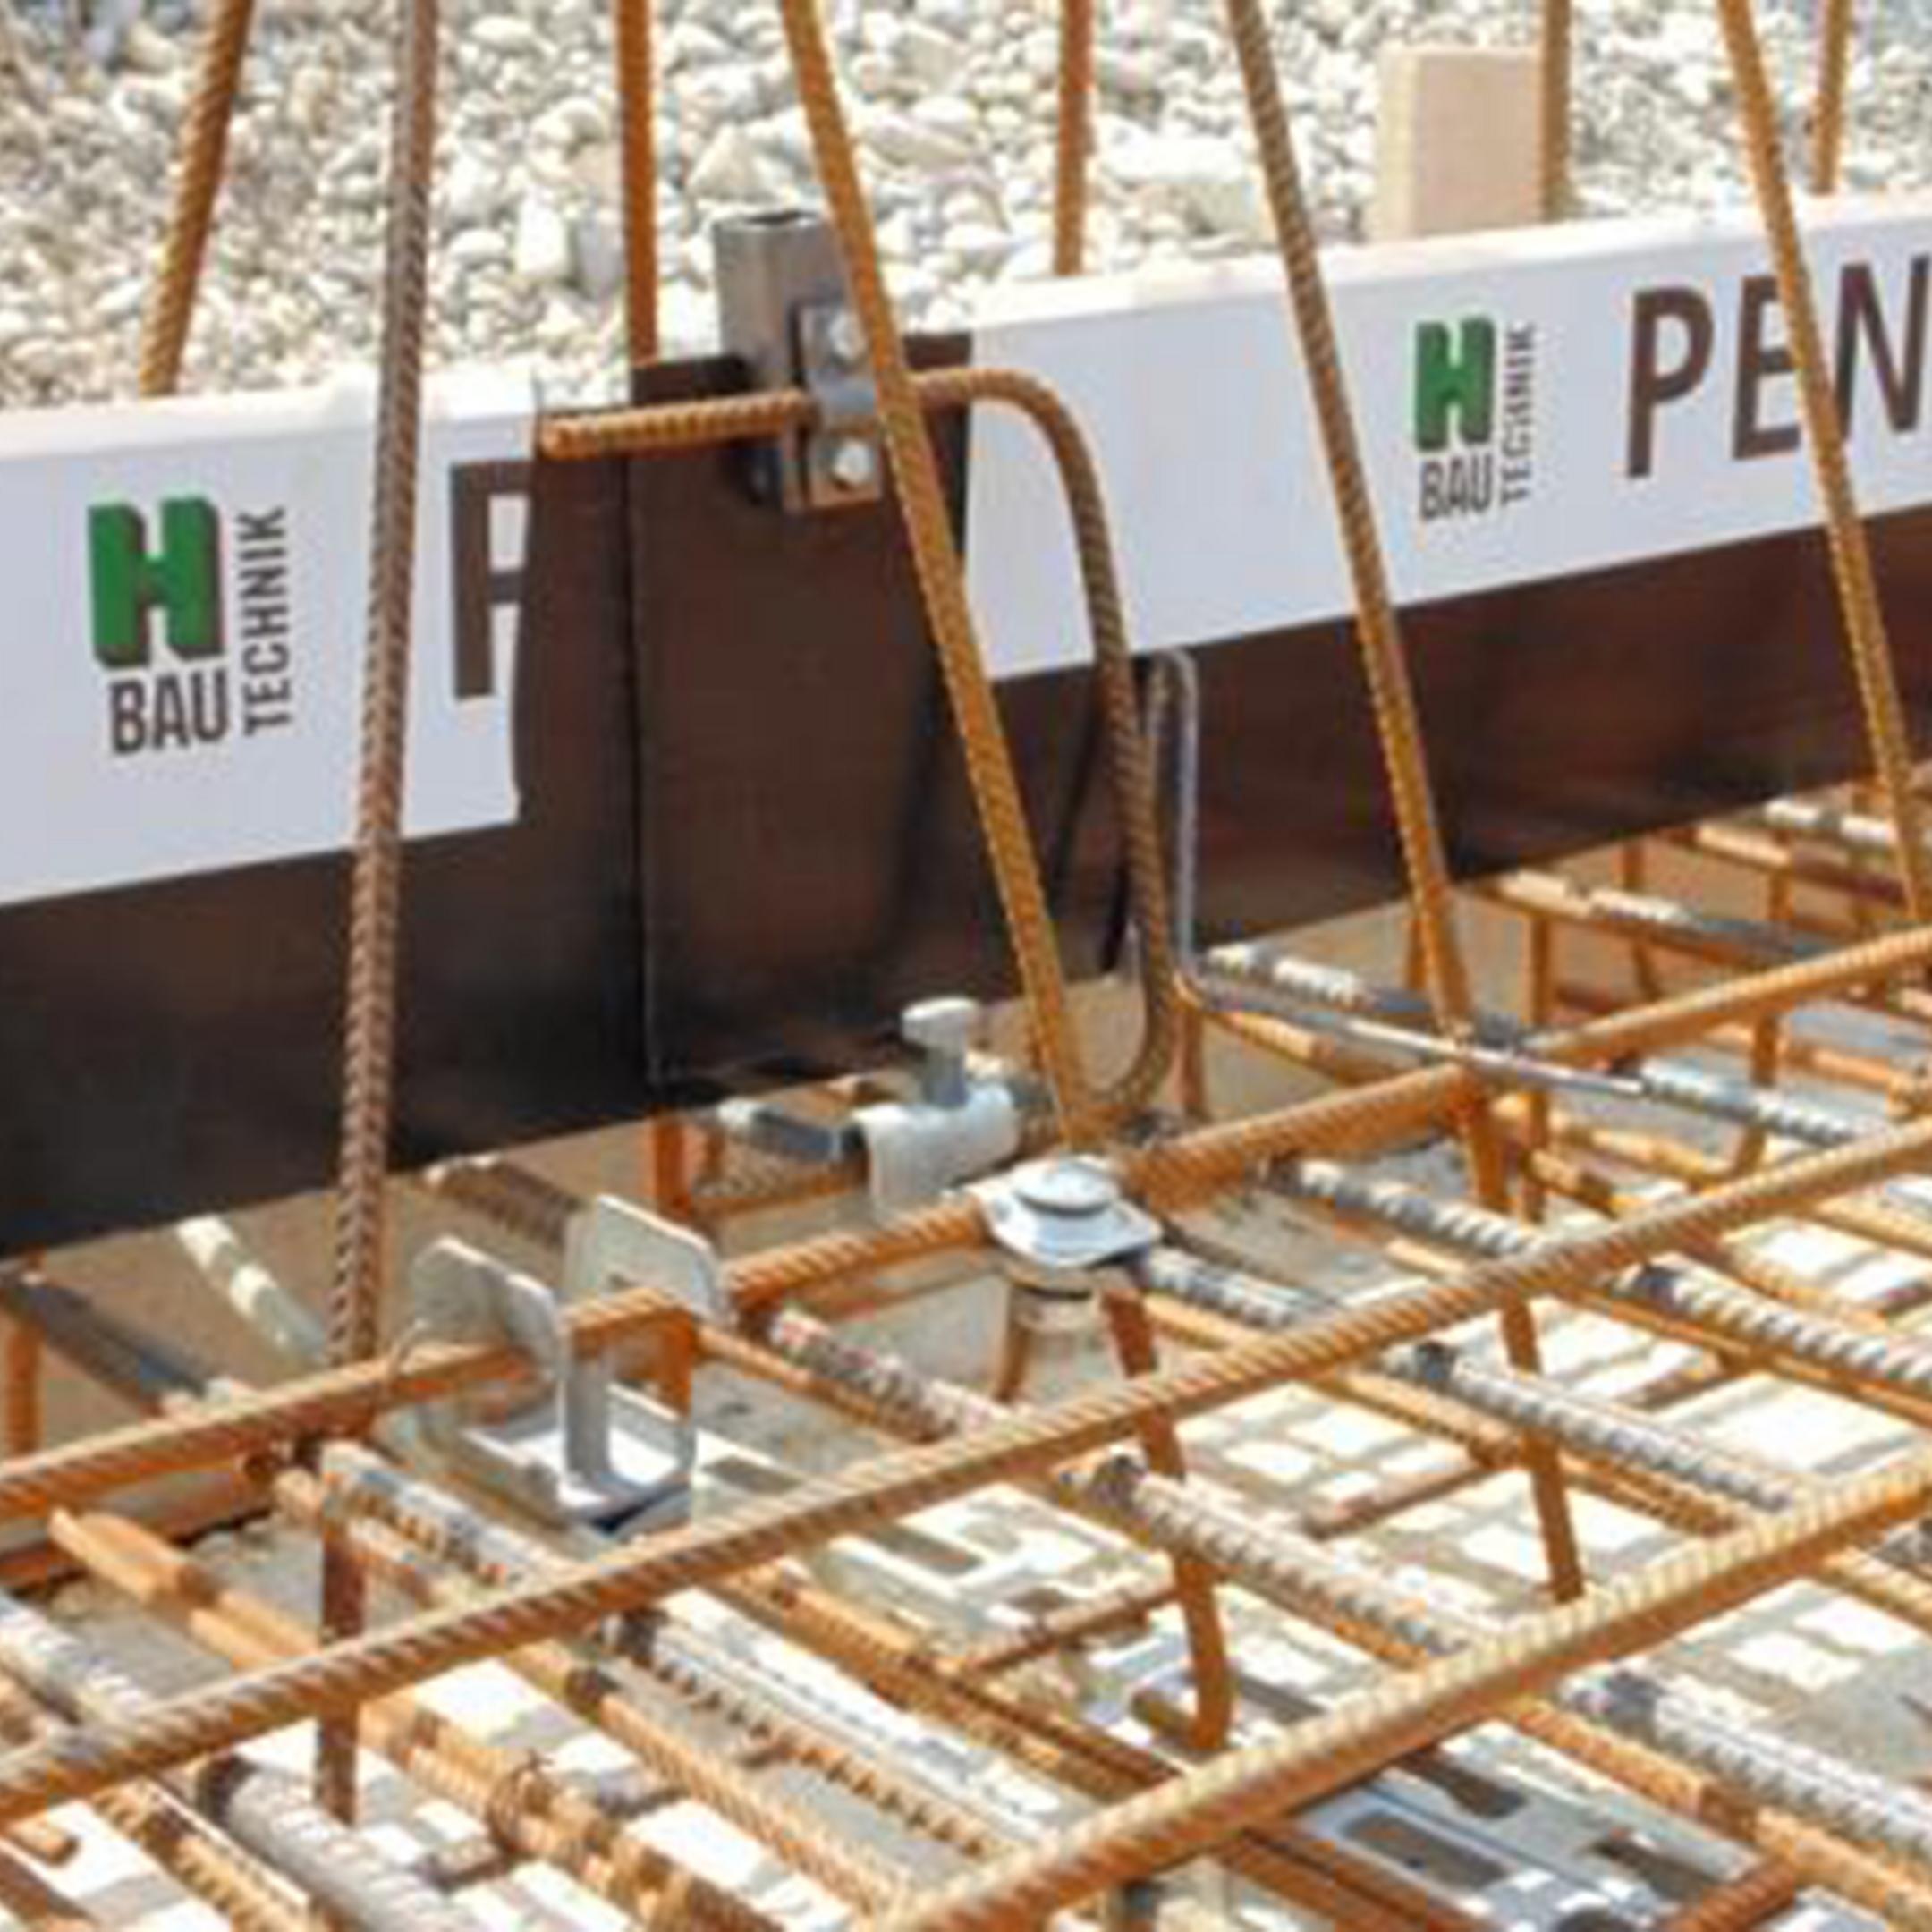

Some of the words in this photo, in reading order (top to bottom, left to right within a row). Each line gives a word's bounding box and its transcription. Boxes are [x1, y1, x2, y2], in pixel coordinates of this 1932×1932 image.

[1415, 317, 1496, 453] H
[1420, 454, 1494, 521] BAU
[89, 496, 225, 669] H
[236, 505, 292, 737] TECHNIK
[111, 670, 228, 755] BAU
